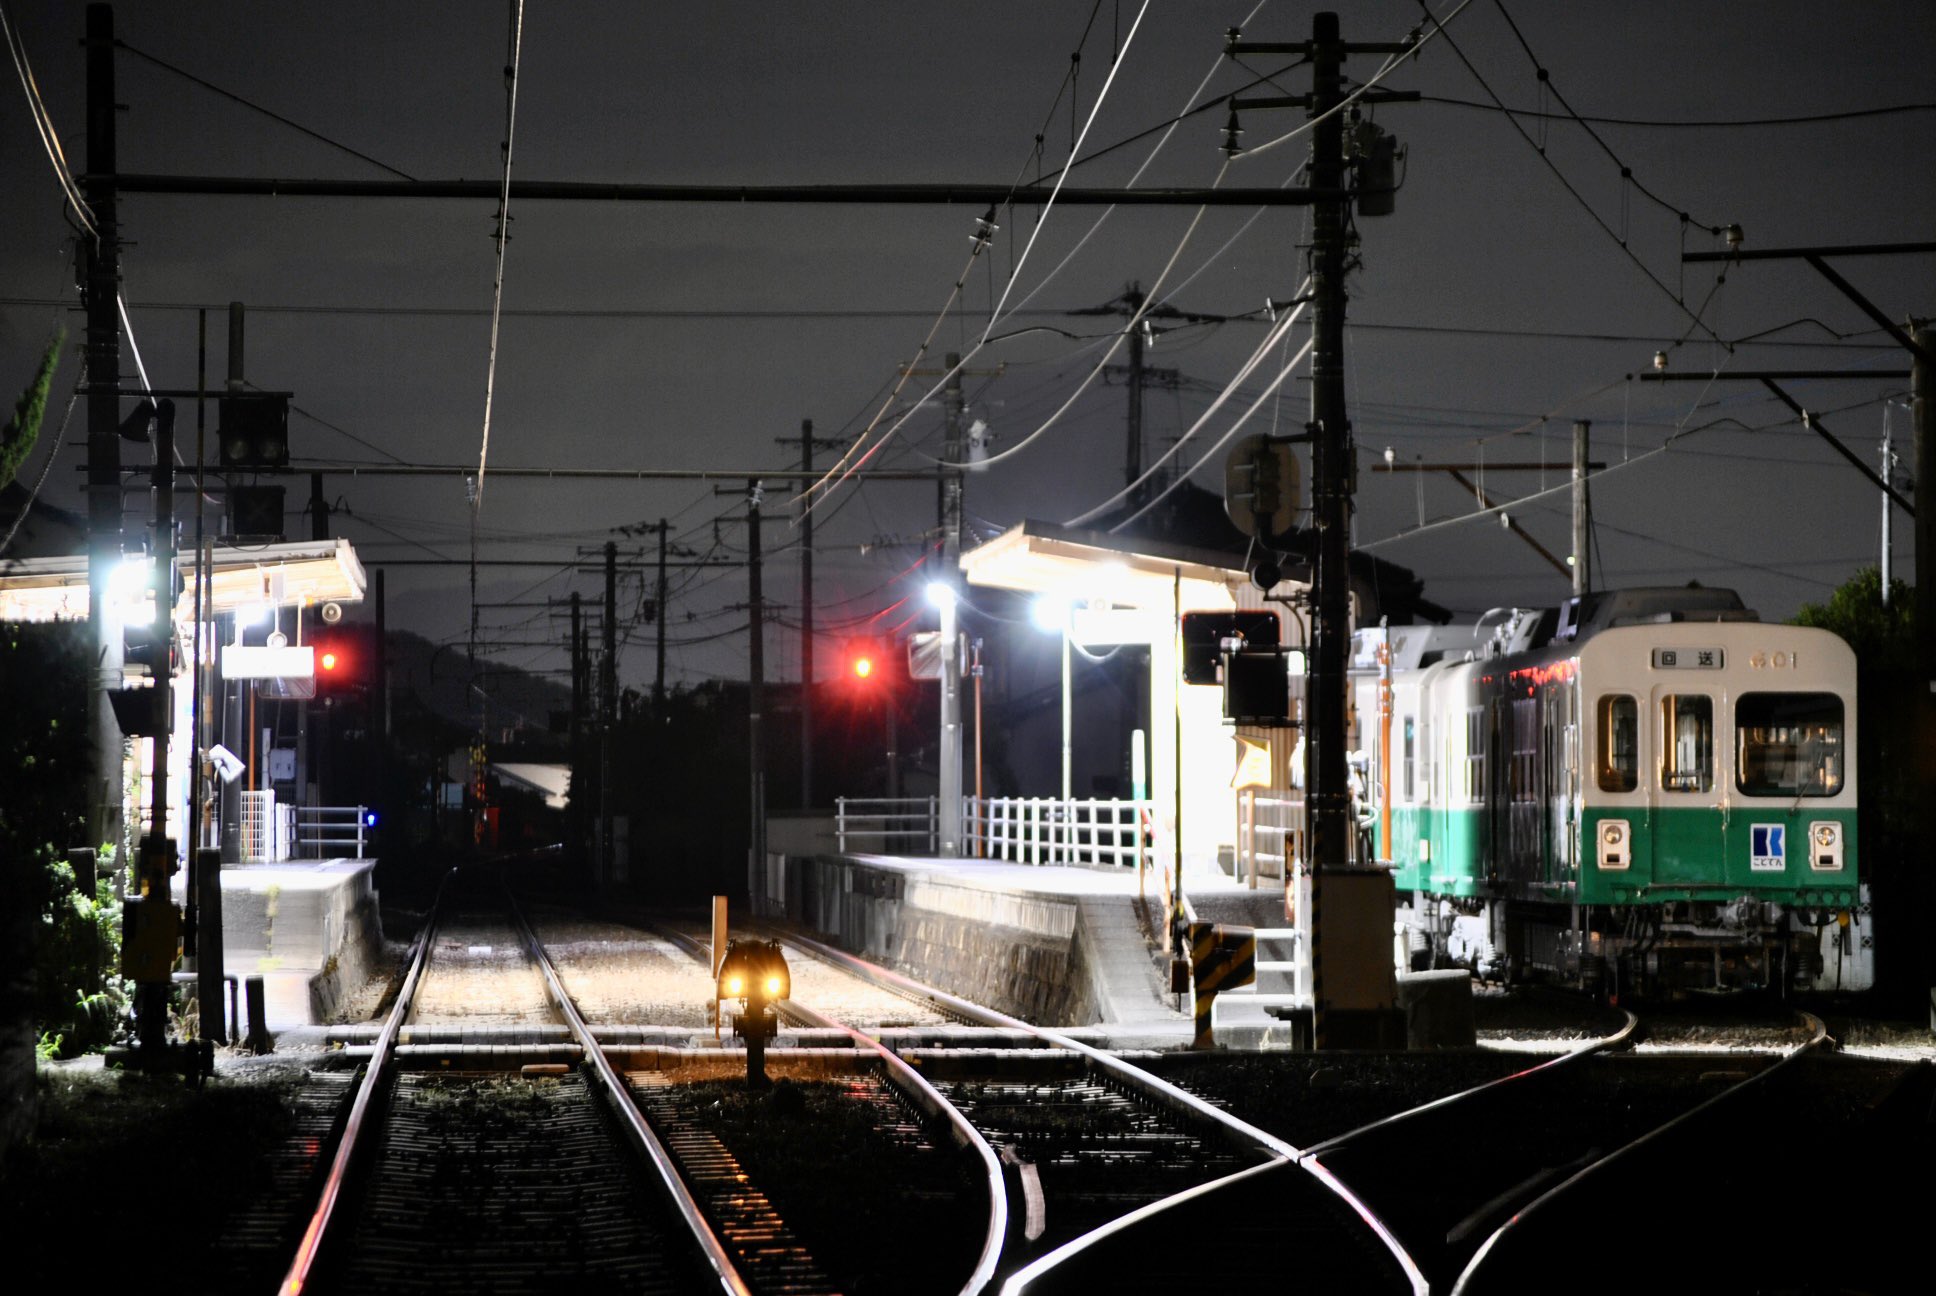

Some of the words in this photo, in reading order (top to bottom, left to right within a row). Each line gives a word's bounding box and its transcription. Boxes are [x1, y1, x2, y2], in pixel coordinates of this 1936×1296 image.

[1661, 651, 1713, 666] 回送
[1753, 857, 1783, 867] ことでん
